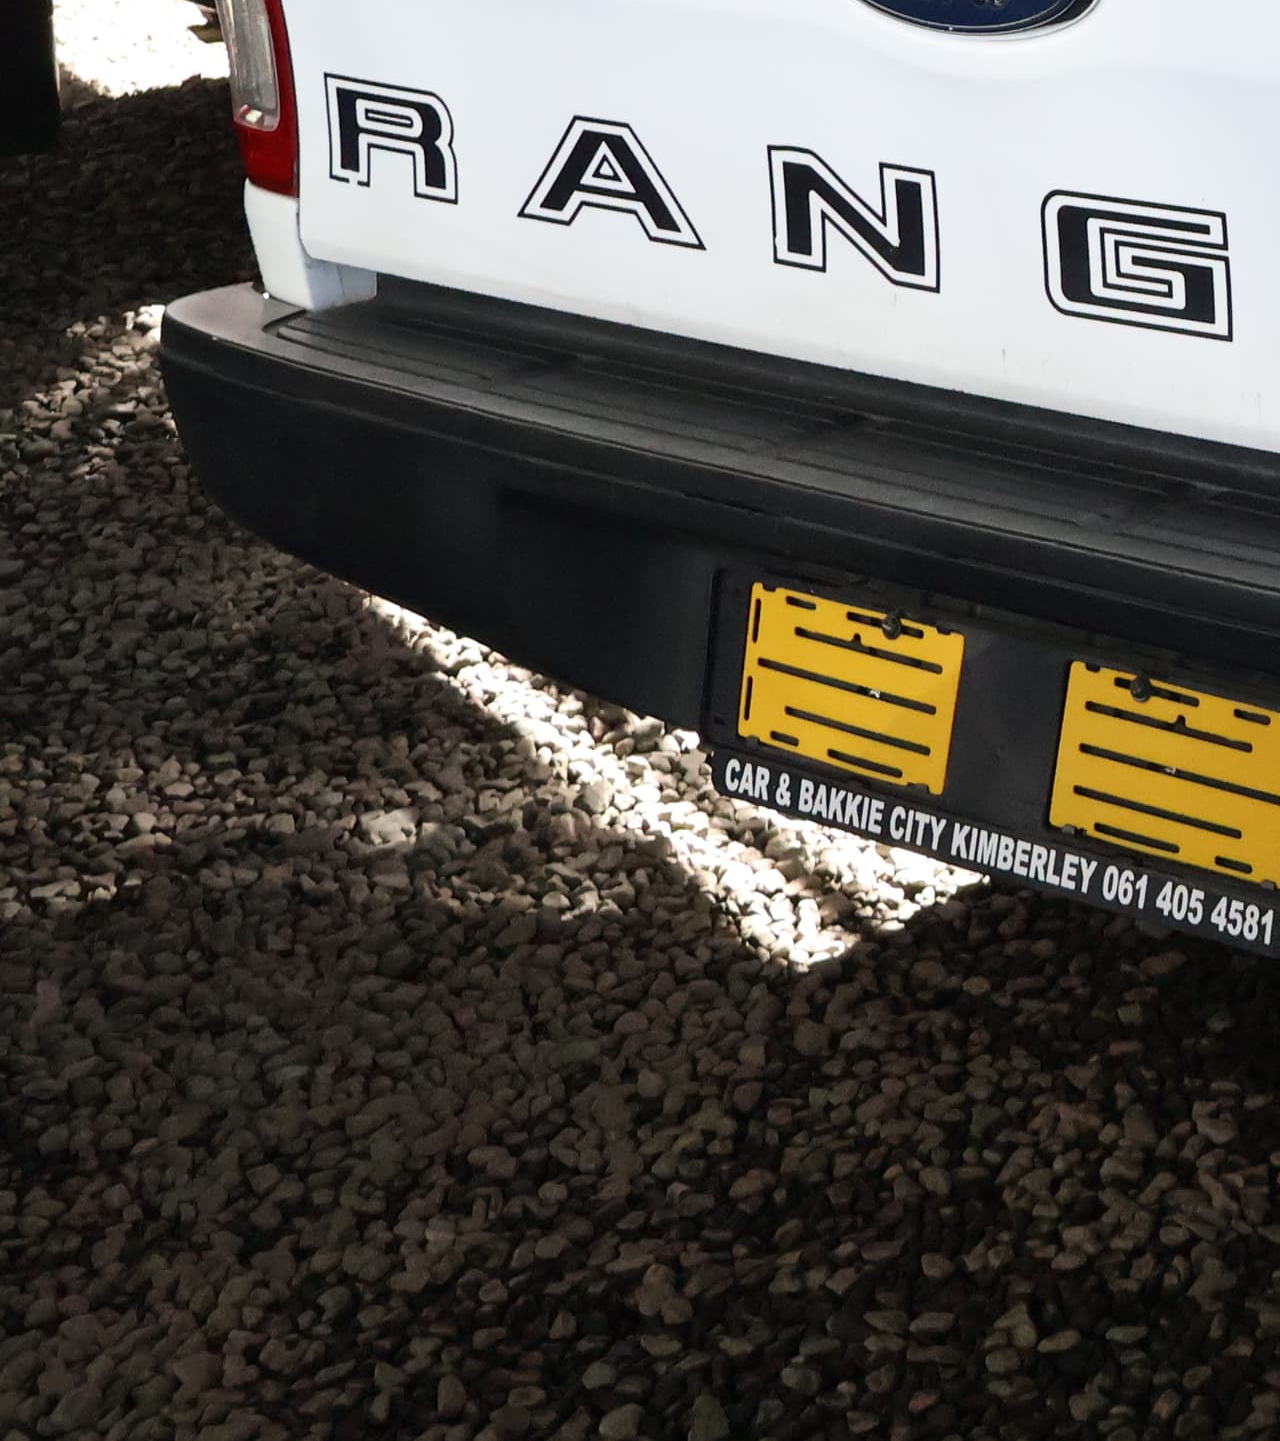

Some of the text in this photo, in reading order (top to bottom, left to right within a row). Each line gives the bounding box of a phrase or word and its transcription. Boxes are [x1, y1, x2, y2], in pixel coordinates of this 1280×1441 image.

[724, 758, 1275, 946] CAR & BAKKIE CITY KIMBERLEY 061 405 4581
